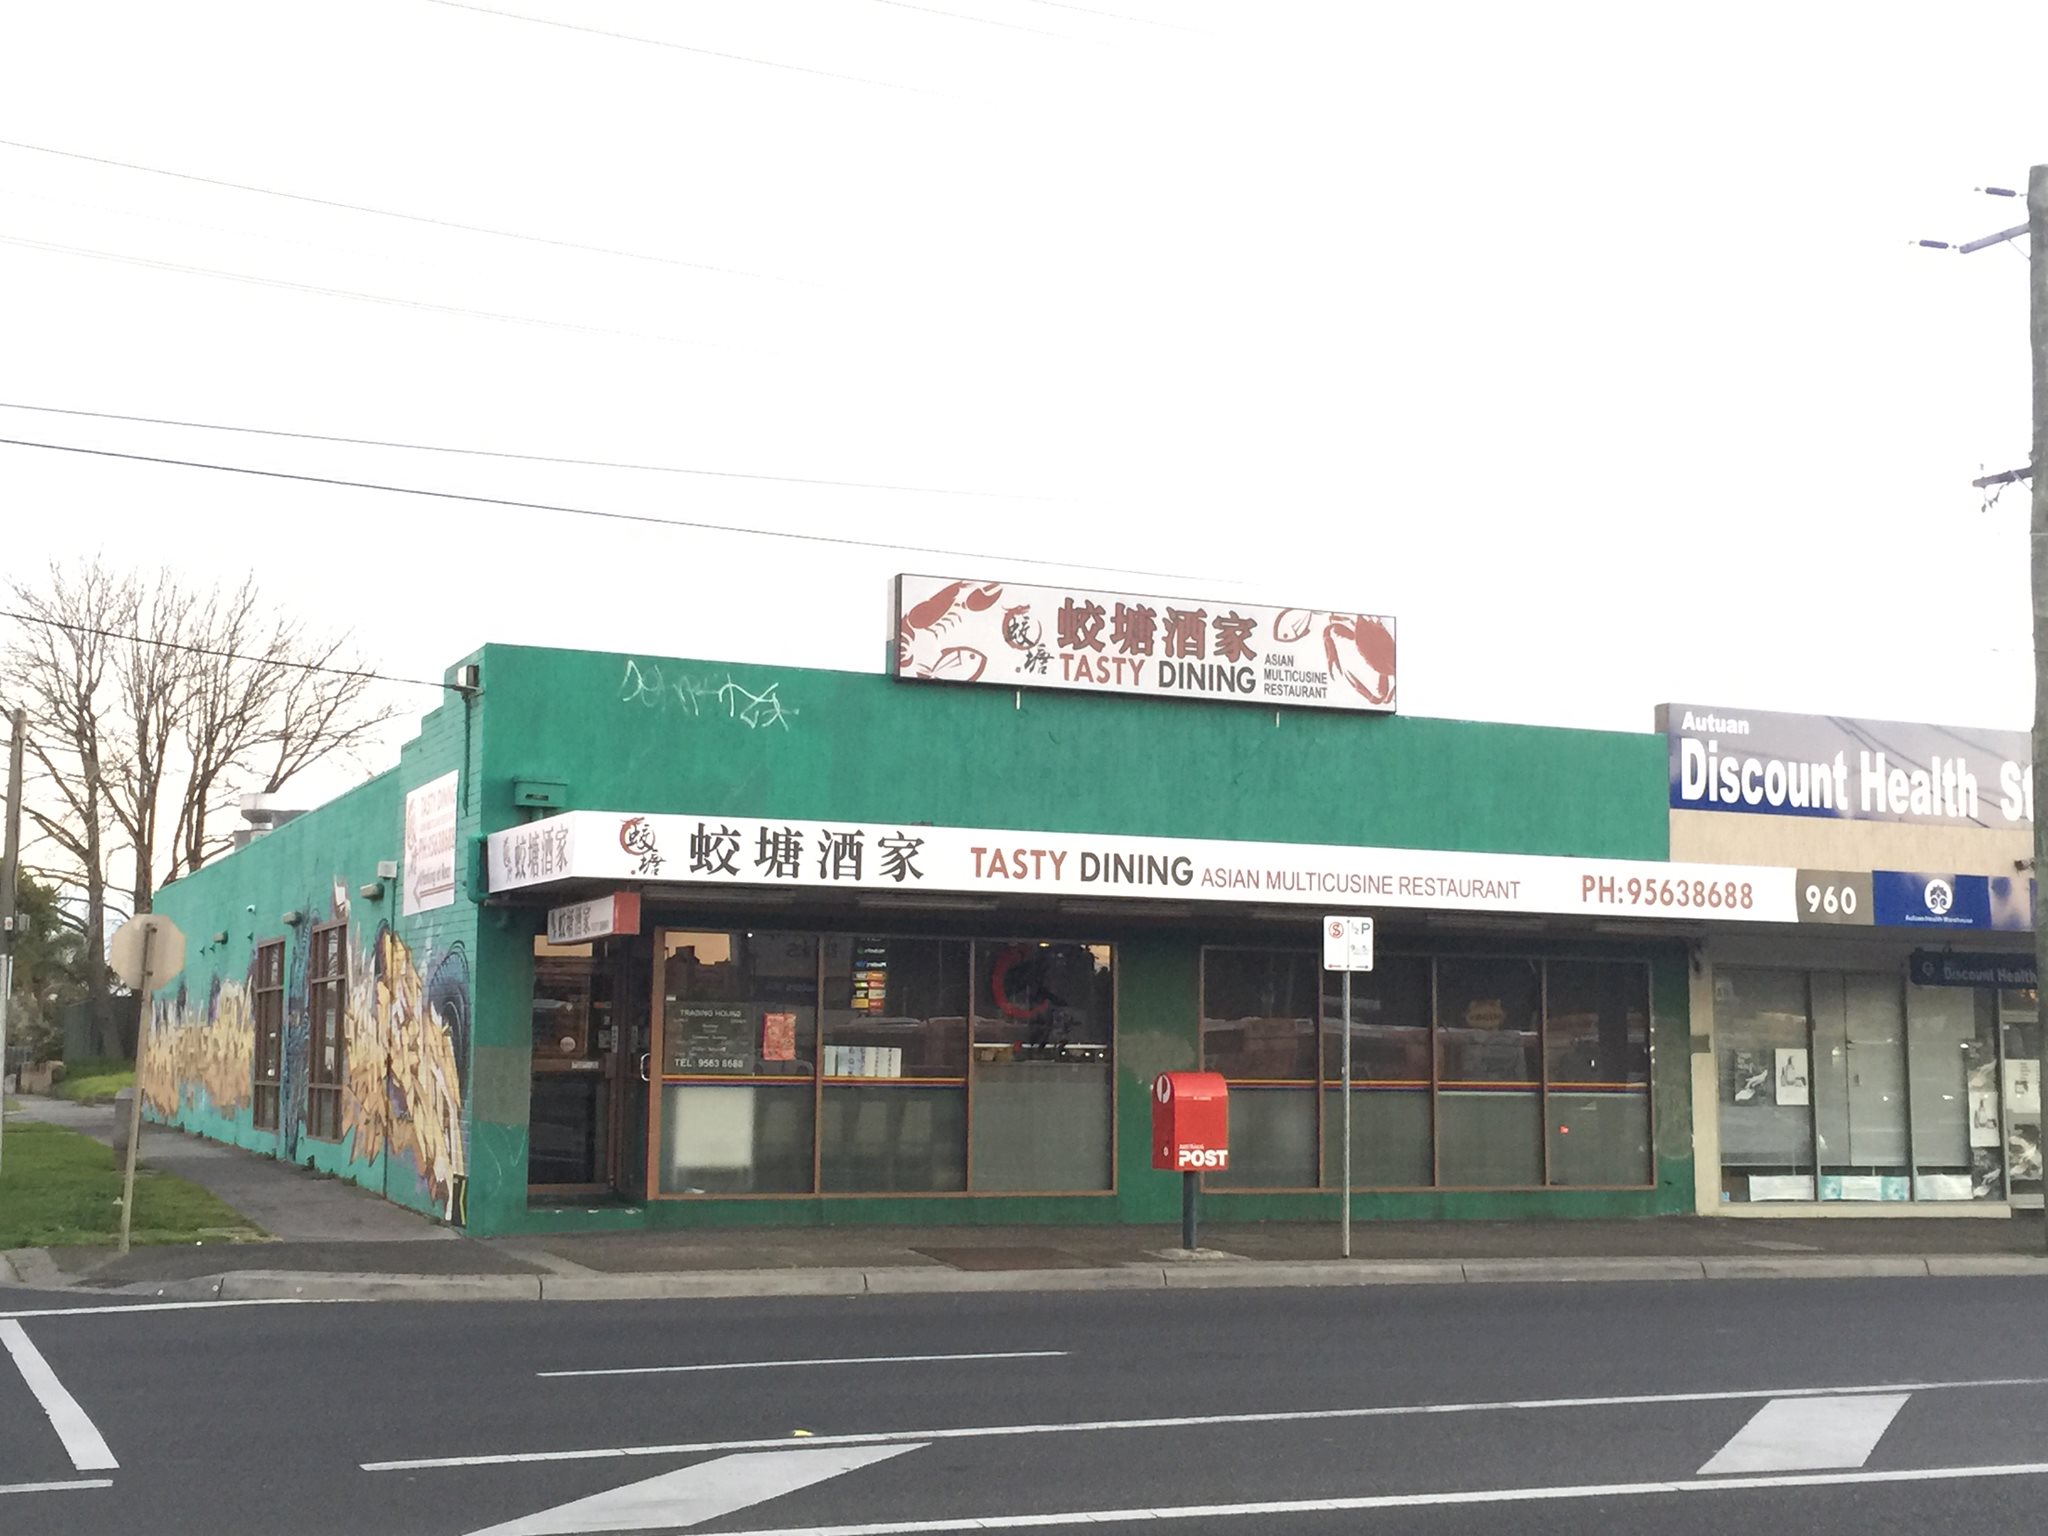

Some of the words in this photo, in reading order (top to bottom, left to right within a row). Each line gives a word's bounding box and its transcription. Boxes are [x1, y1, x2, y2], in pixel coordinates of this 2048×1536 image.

[1057, 597, 1257, 663] 蛟塘酒家
[1264, 653, 1295, 667] ASIAN
[1059, 653, 1145, 686] TASTY
[1159, 660, 1256, 694] DINING
[1264, 668, 1328, 684] MULTICUSINE
[1264, 683, 1328, 699] RESTAURANT
[1681, 711, 1750, 735] Autuan
[1681, 737, 1848, 811] Discount
[1860, 751, 1978, 818] Health
[689, 822, 925, 882] 蛟塘酒家
[970, 847, 1067, 881] TASTY
[1080, 852, 1194, 886] DINING
[1201, 868, 1260, 889] ASIAN
[1266, 871, 1393, 895] MULTICUSINE
[1399, 876, 1521, 899] RESTAURANT
[1582, 875, 1753, 909] PH:95638688
[1805, 884, 1857, 915] 960
[1944, 967, 1994, 982] Discount
[680, 1009, 713, 1017] TRADING
[674, 1058, 693, 1067] TEL
[1179, 1150, 1228, 1167] POST
